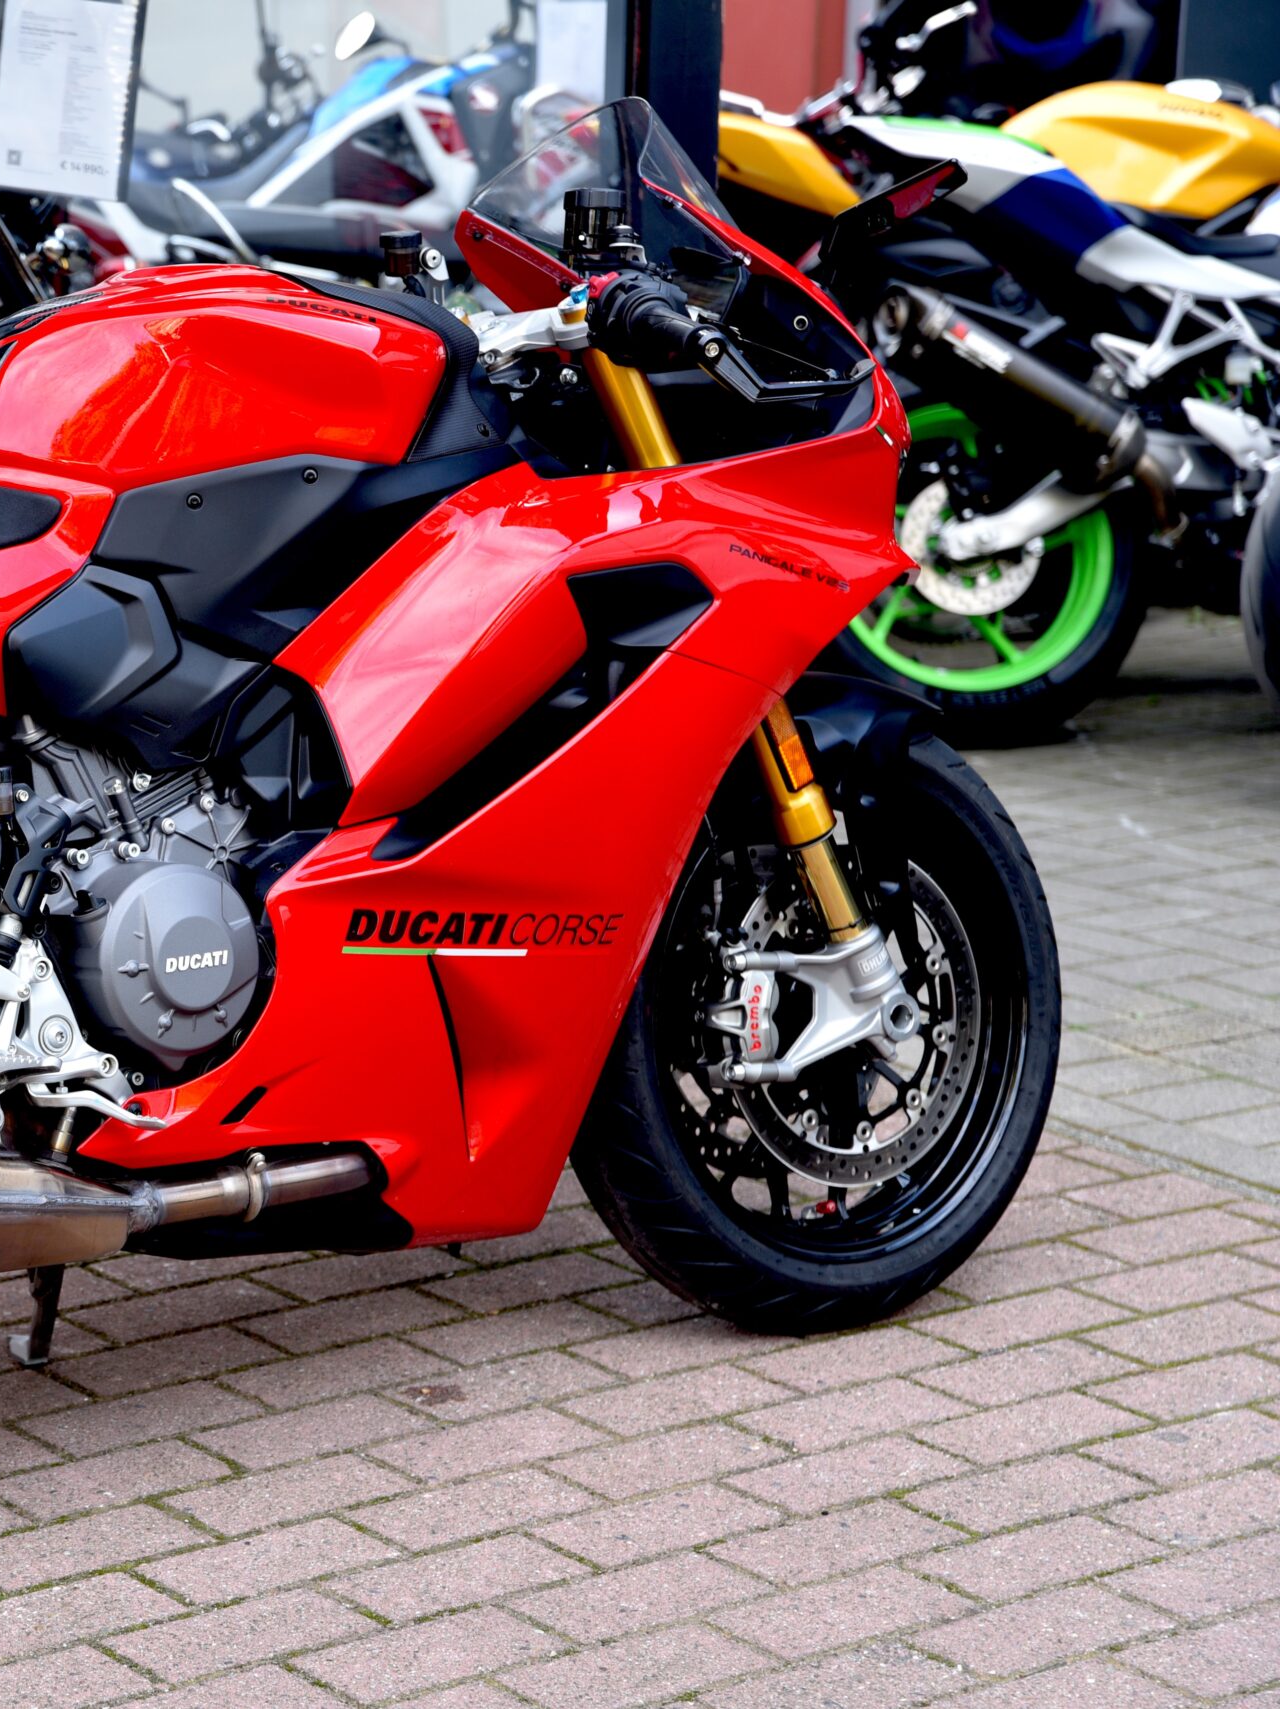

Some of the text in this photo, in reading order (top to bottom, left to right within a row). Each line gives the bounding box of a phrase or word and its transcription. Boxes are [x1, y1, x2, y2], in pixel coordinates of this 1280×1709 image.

[266, 296, 377, 323] DUCATI
[729, 544, 812, 578] PANIGALE
[345, 908, 624, 945] DUCATI CORSE
[165, 949, 228, 973] DUCATI
[748, 984, 762, 1052] brembo
